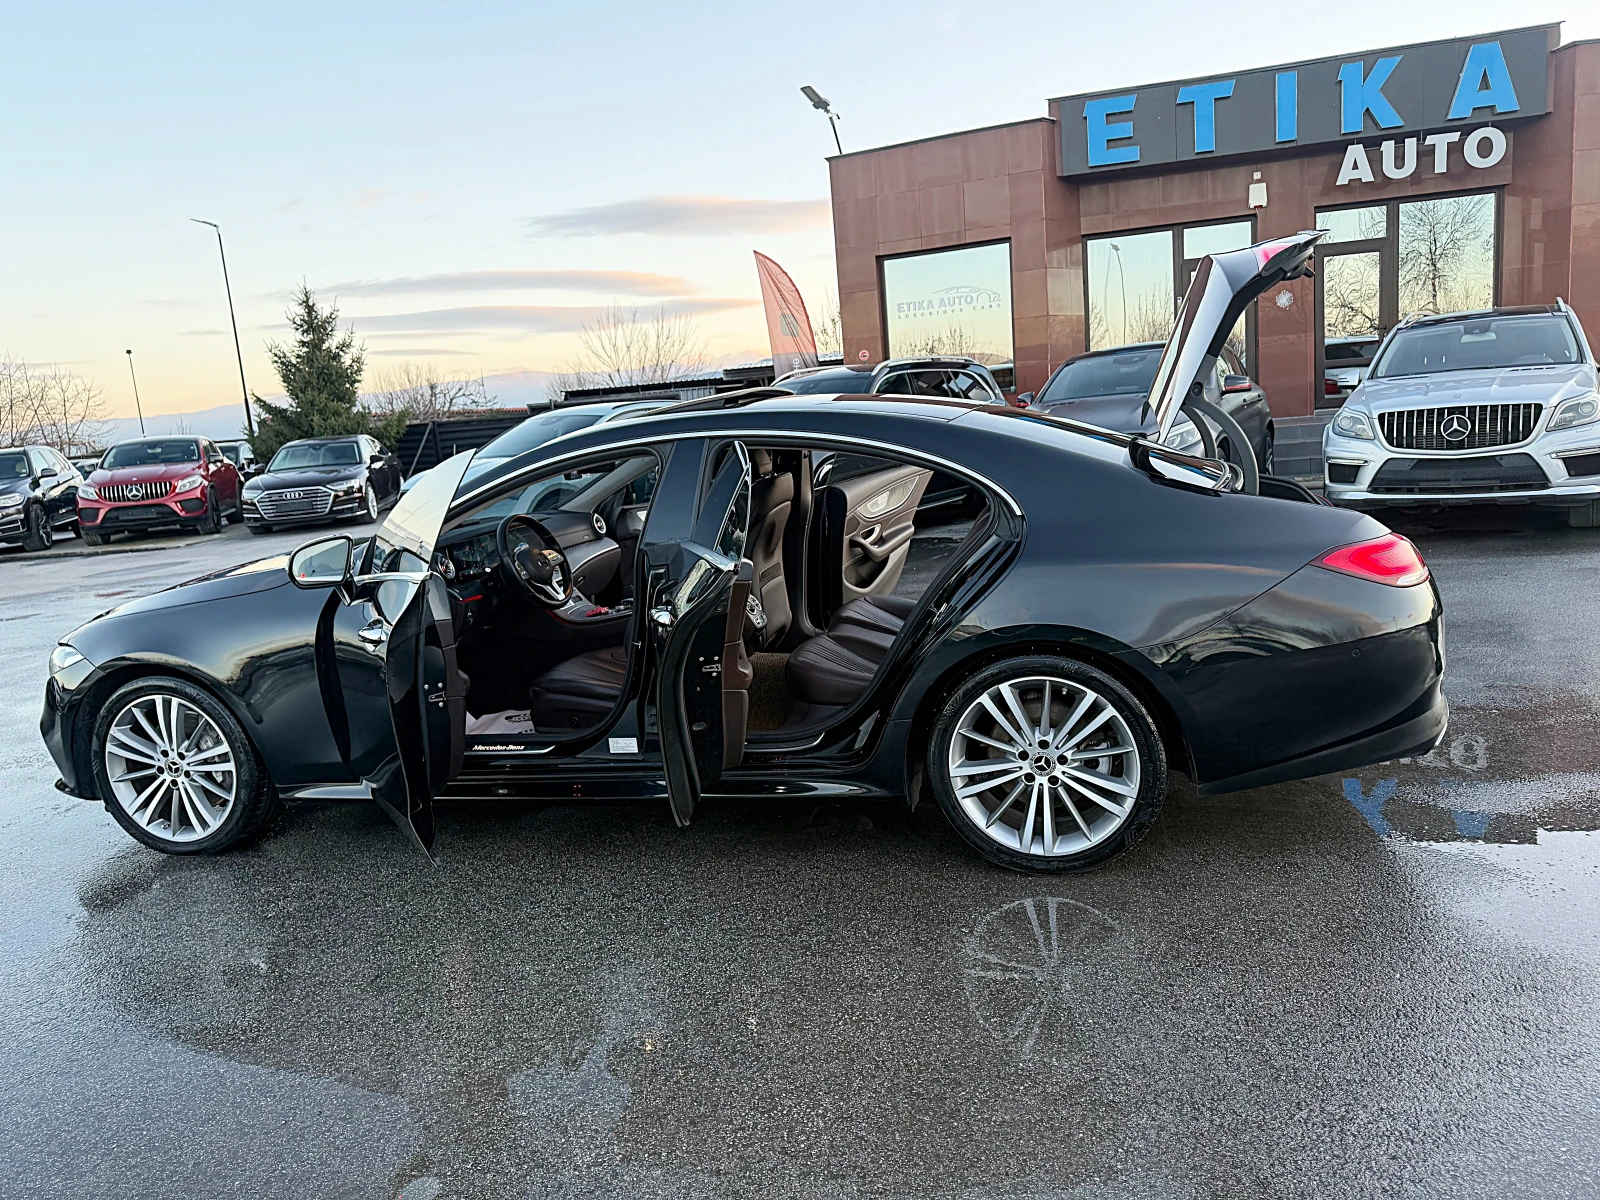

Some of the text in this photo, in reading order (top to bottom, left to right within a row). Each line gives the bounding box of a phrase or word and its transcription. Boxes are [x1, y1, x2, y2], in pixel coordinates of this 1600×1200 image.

[1082, 40, 1520, 167] ETIKA
[1335, 126, 1507, 186] AUTO
[897, 294, 974, 313] ETIKA AUTO
[897, 309, 963, 319] LUXURIOUS
